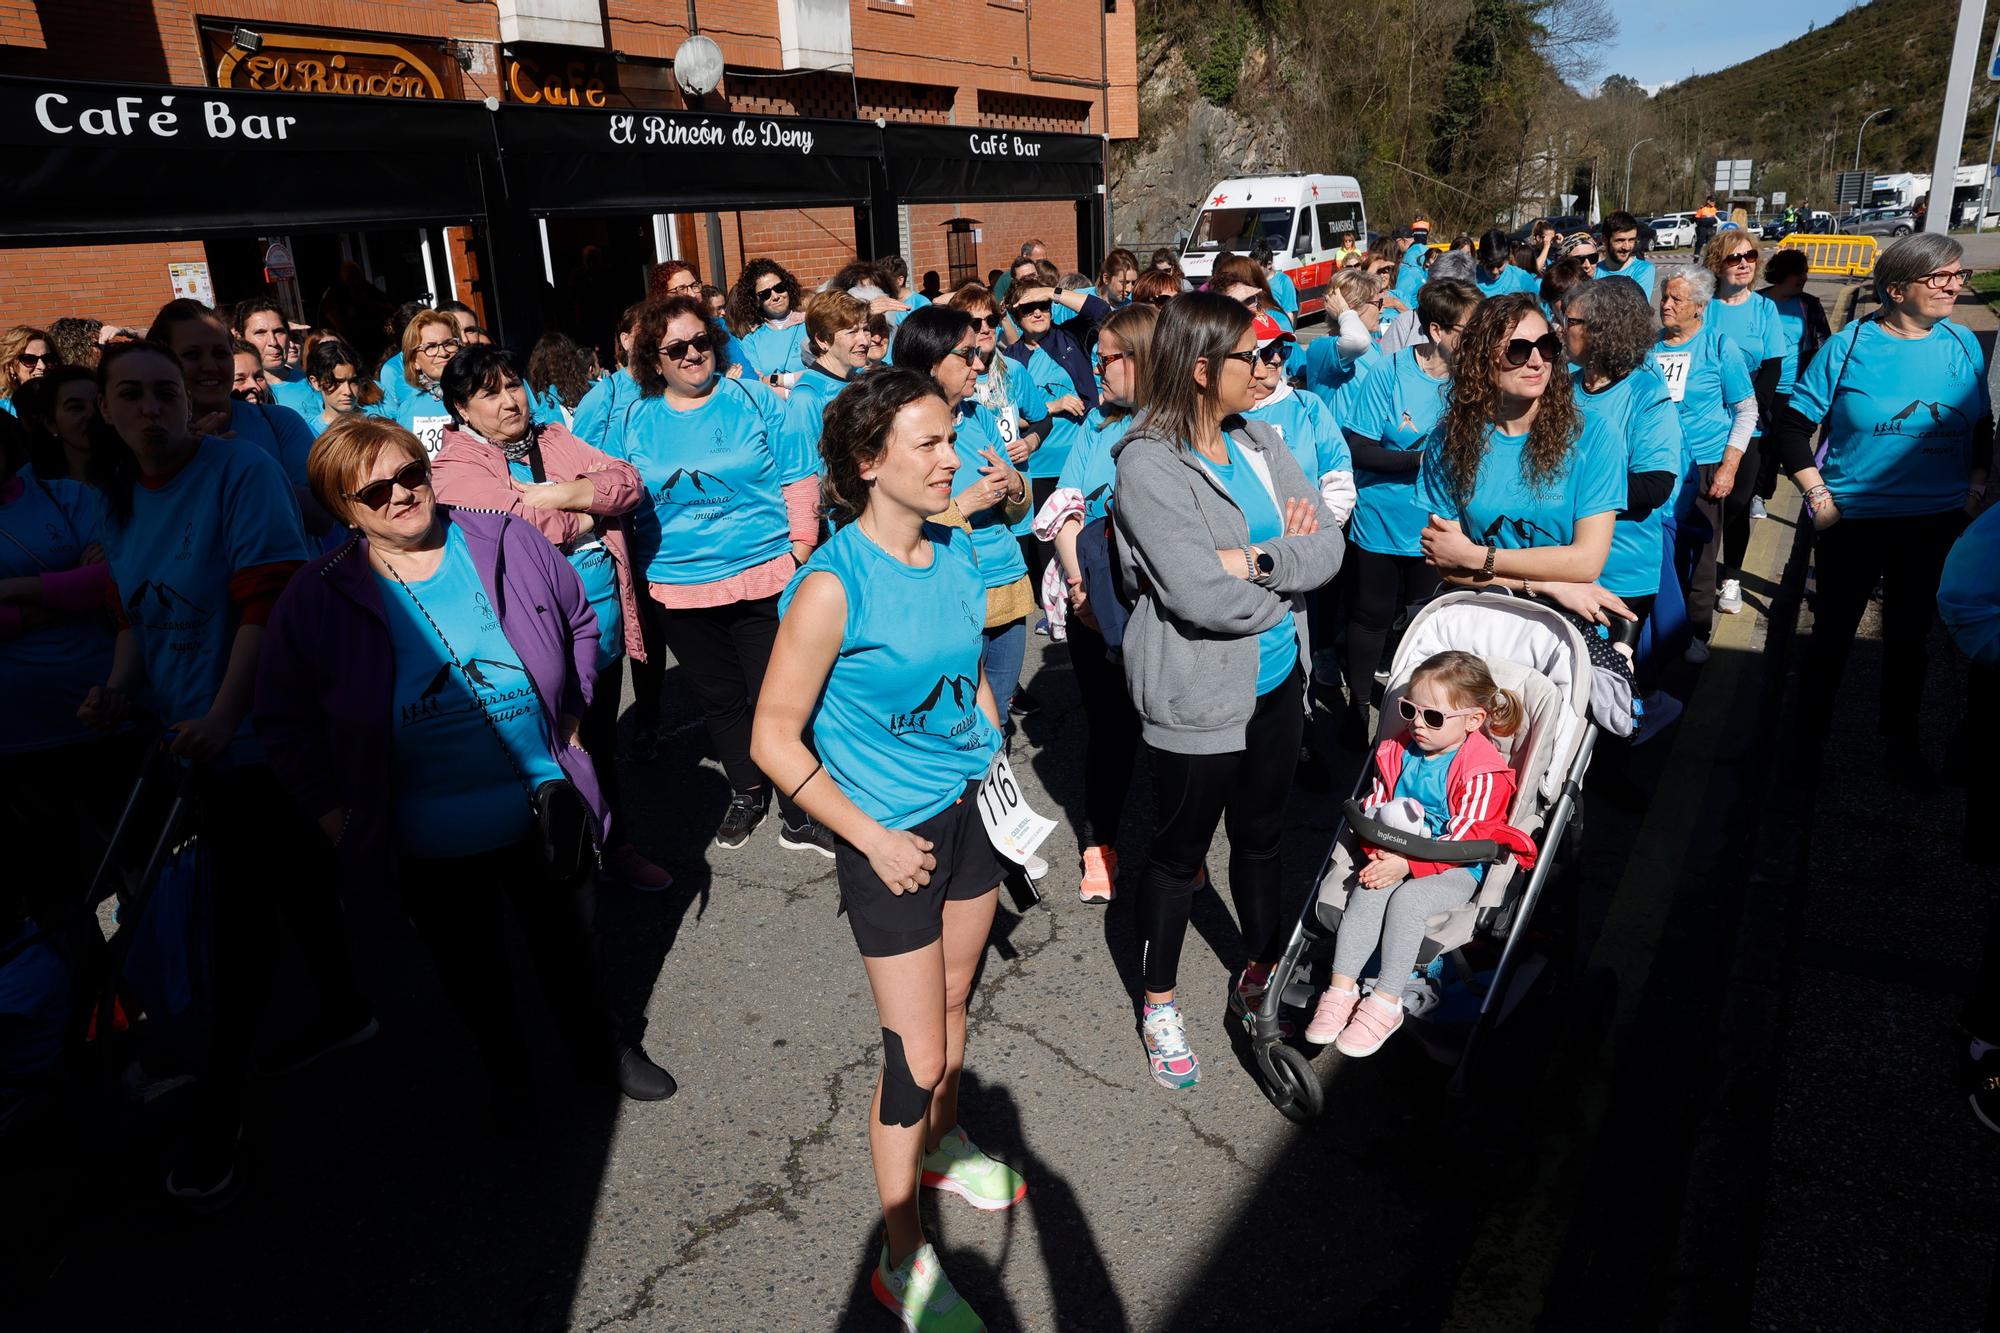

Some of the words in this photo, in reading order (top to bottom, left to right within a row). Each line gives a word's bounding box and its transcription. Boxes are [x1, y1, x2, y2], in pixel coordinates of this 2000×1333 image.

[247, 56, 296, 92] El
[296, 54, 426, 98] Rincón
[203, 101, 297, 140] Bar
[609, 114, 637, 144] El
[643, 116, 726, 145] Rincón
[732, 120, 757, 146] de
[760, 121, 814, 154] Deny
[1013, 136, 1041, 156] Bar
[981, 762, 1018, 826] 116
[1377, 830, 1408, 846] Inglesina
